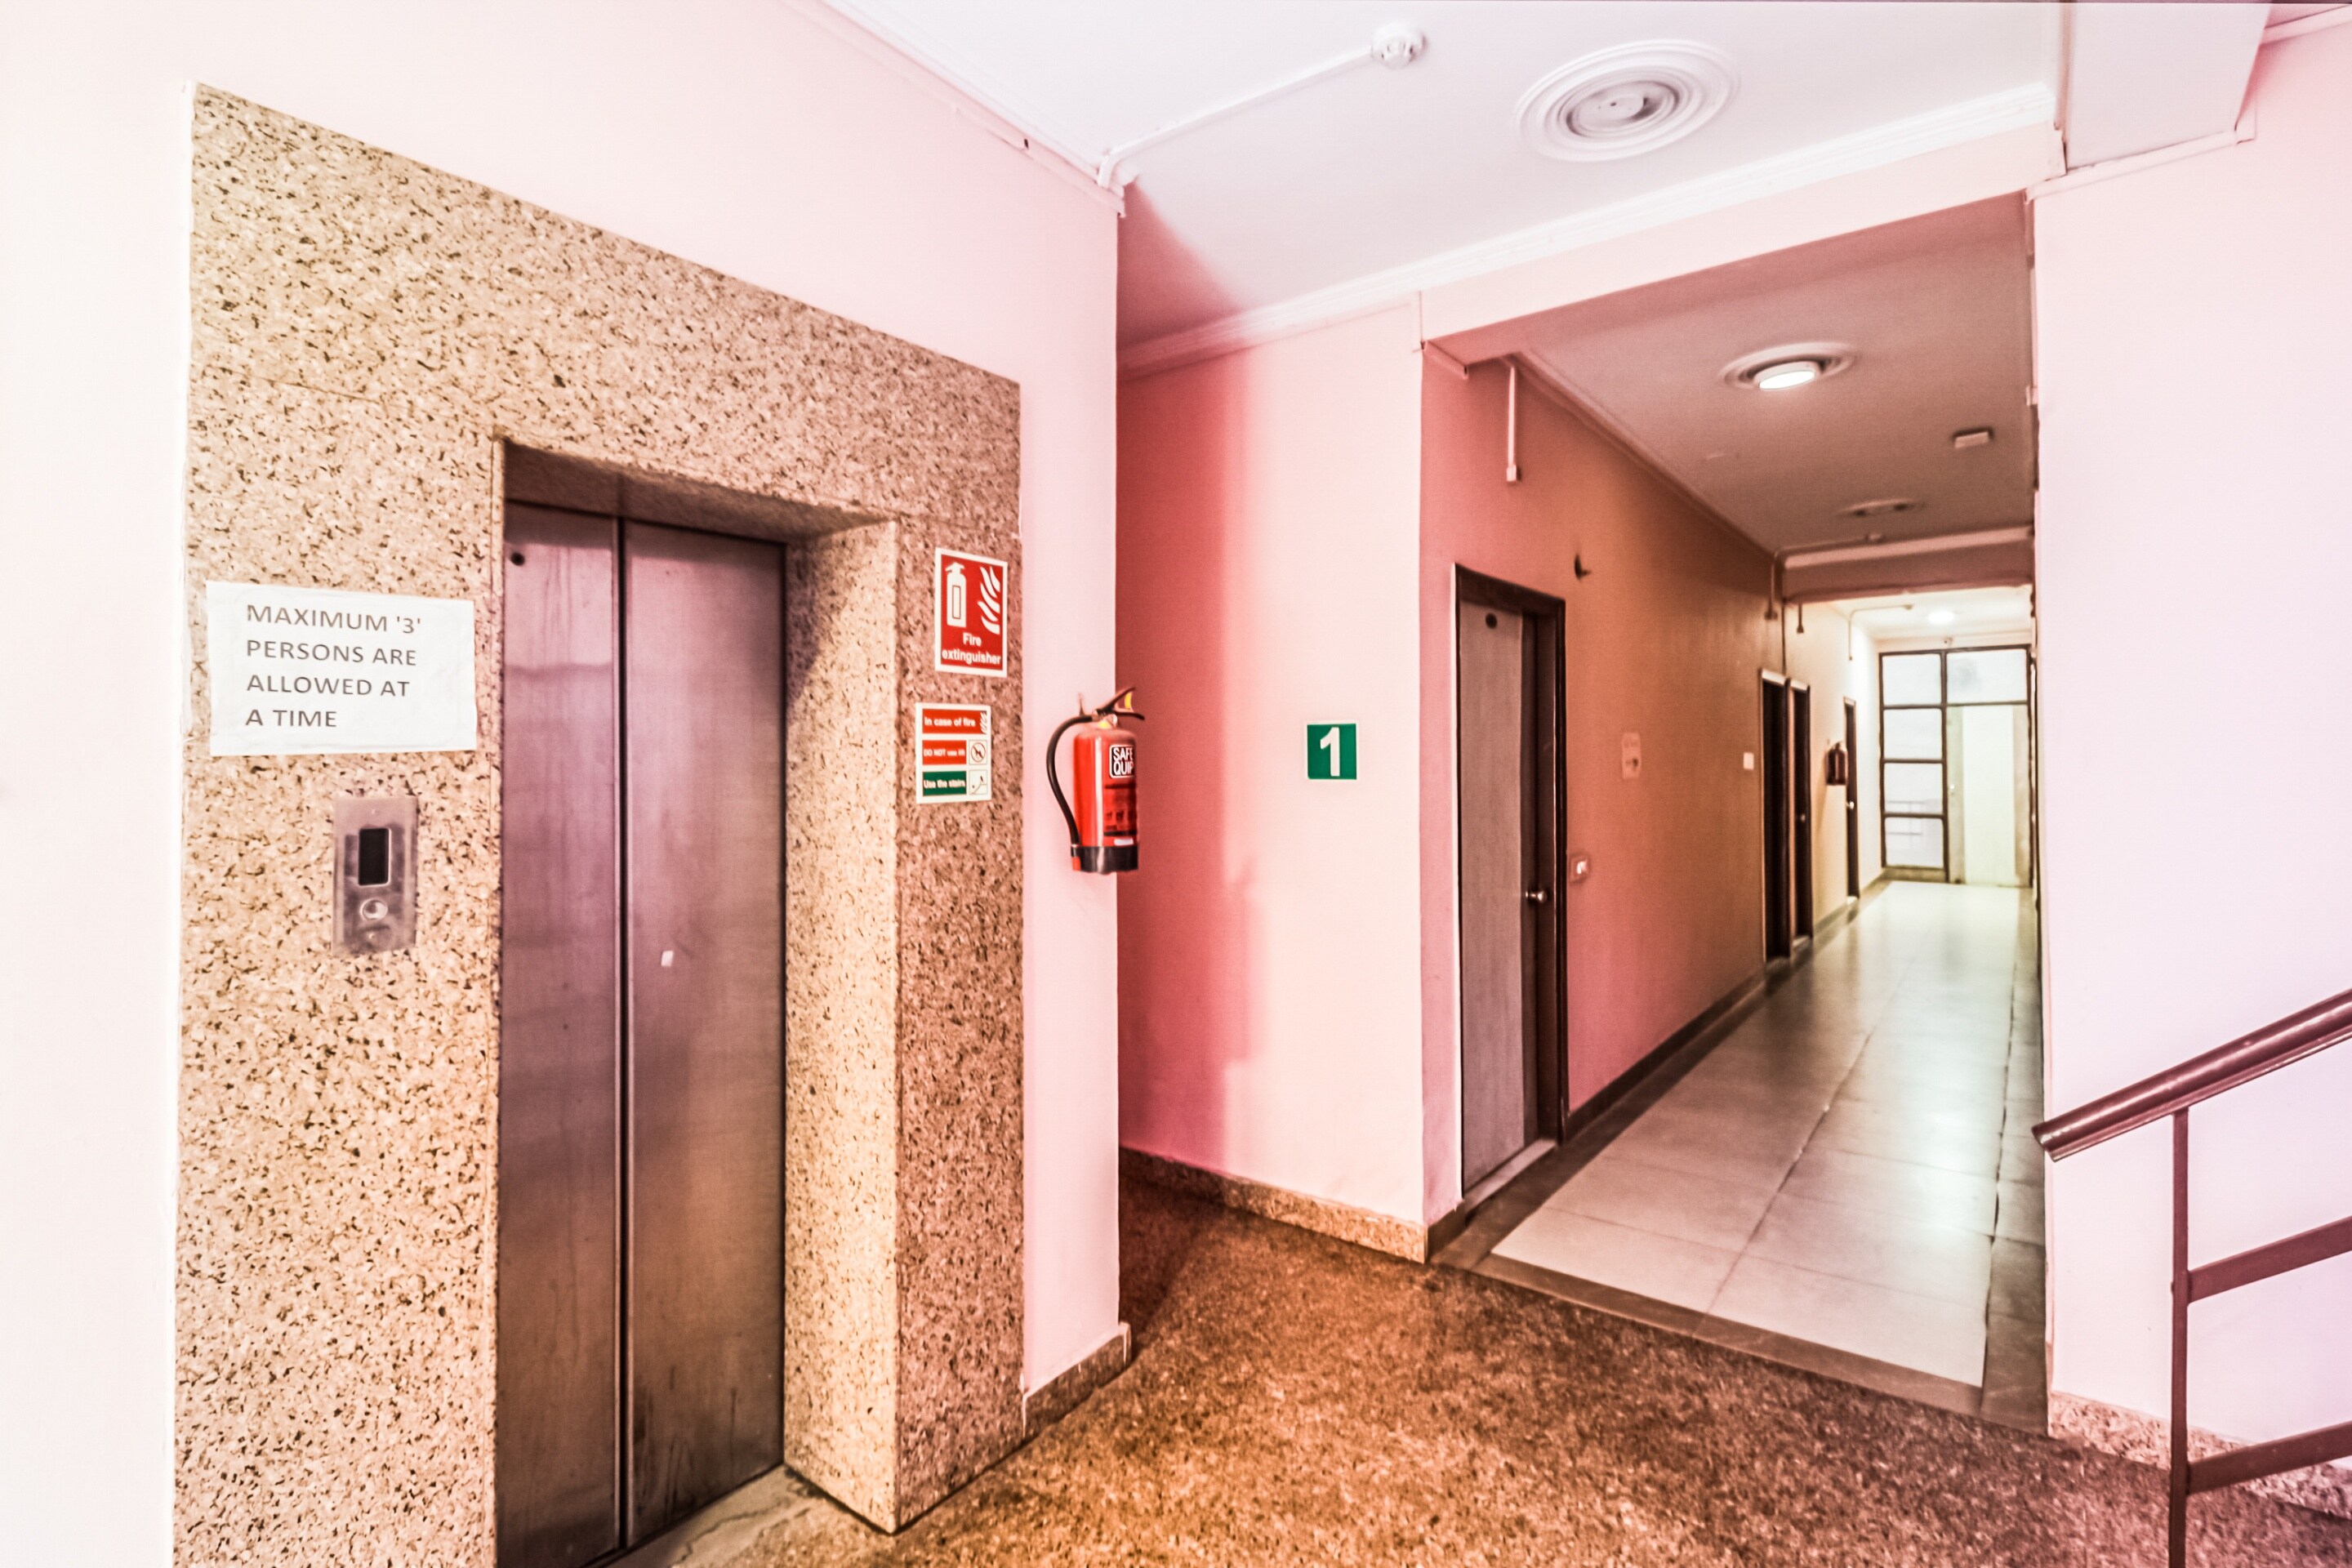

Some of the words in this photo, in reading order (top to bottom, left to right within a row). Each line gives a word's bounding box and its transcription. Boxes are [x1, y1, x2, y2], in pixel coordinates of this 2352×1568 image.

[247, 604, 388, 632] MAXIMUM
[396, 616, 421, 634] '3'
[963, 632, 982, 646] Fire
[247, 639, 364, 663] PERSONS
[372, 648, 417, 666] ARE
[942, 648, 1001, 664] extinguisher
[247, 675, 372, 696] ALLOWED
[380, 680, 411, 697] AT
[245, 709, 264, 727] A
[272, 709, 337, 728] TIME
[933, 718, 952, 727] case
[1320, 726, 1340, 777] 1
[1113, 760, 1134, 775] QUIP
